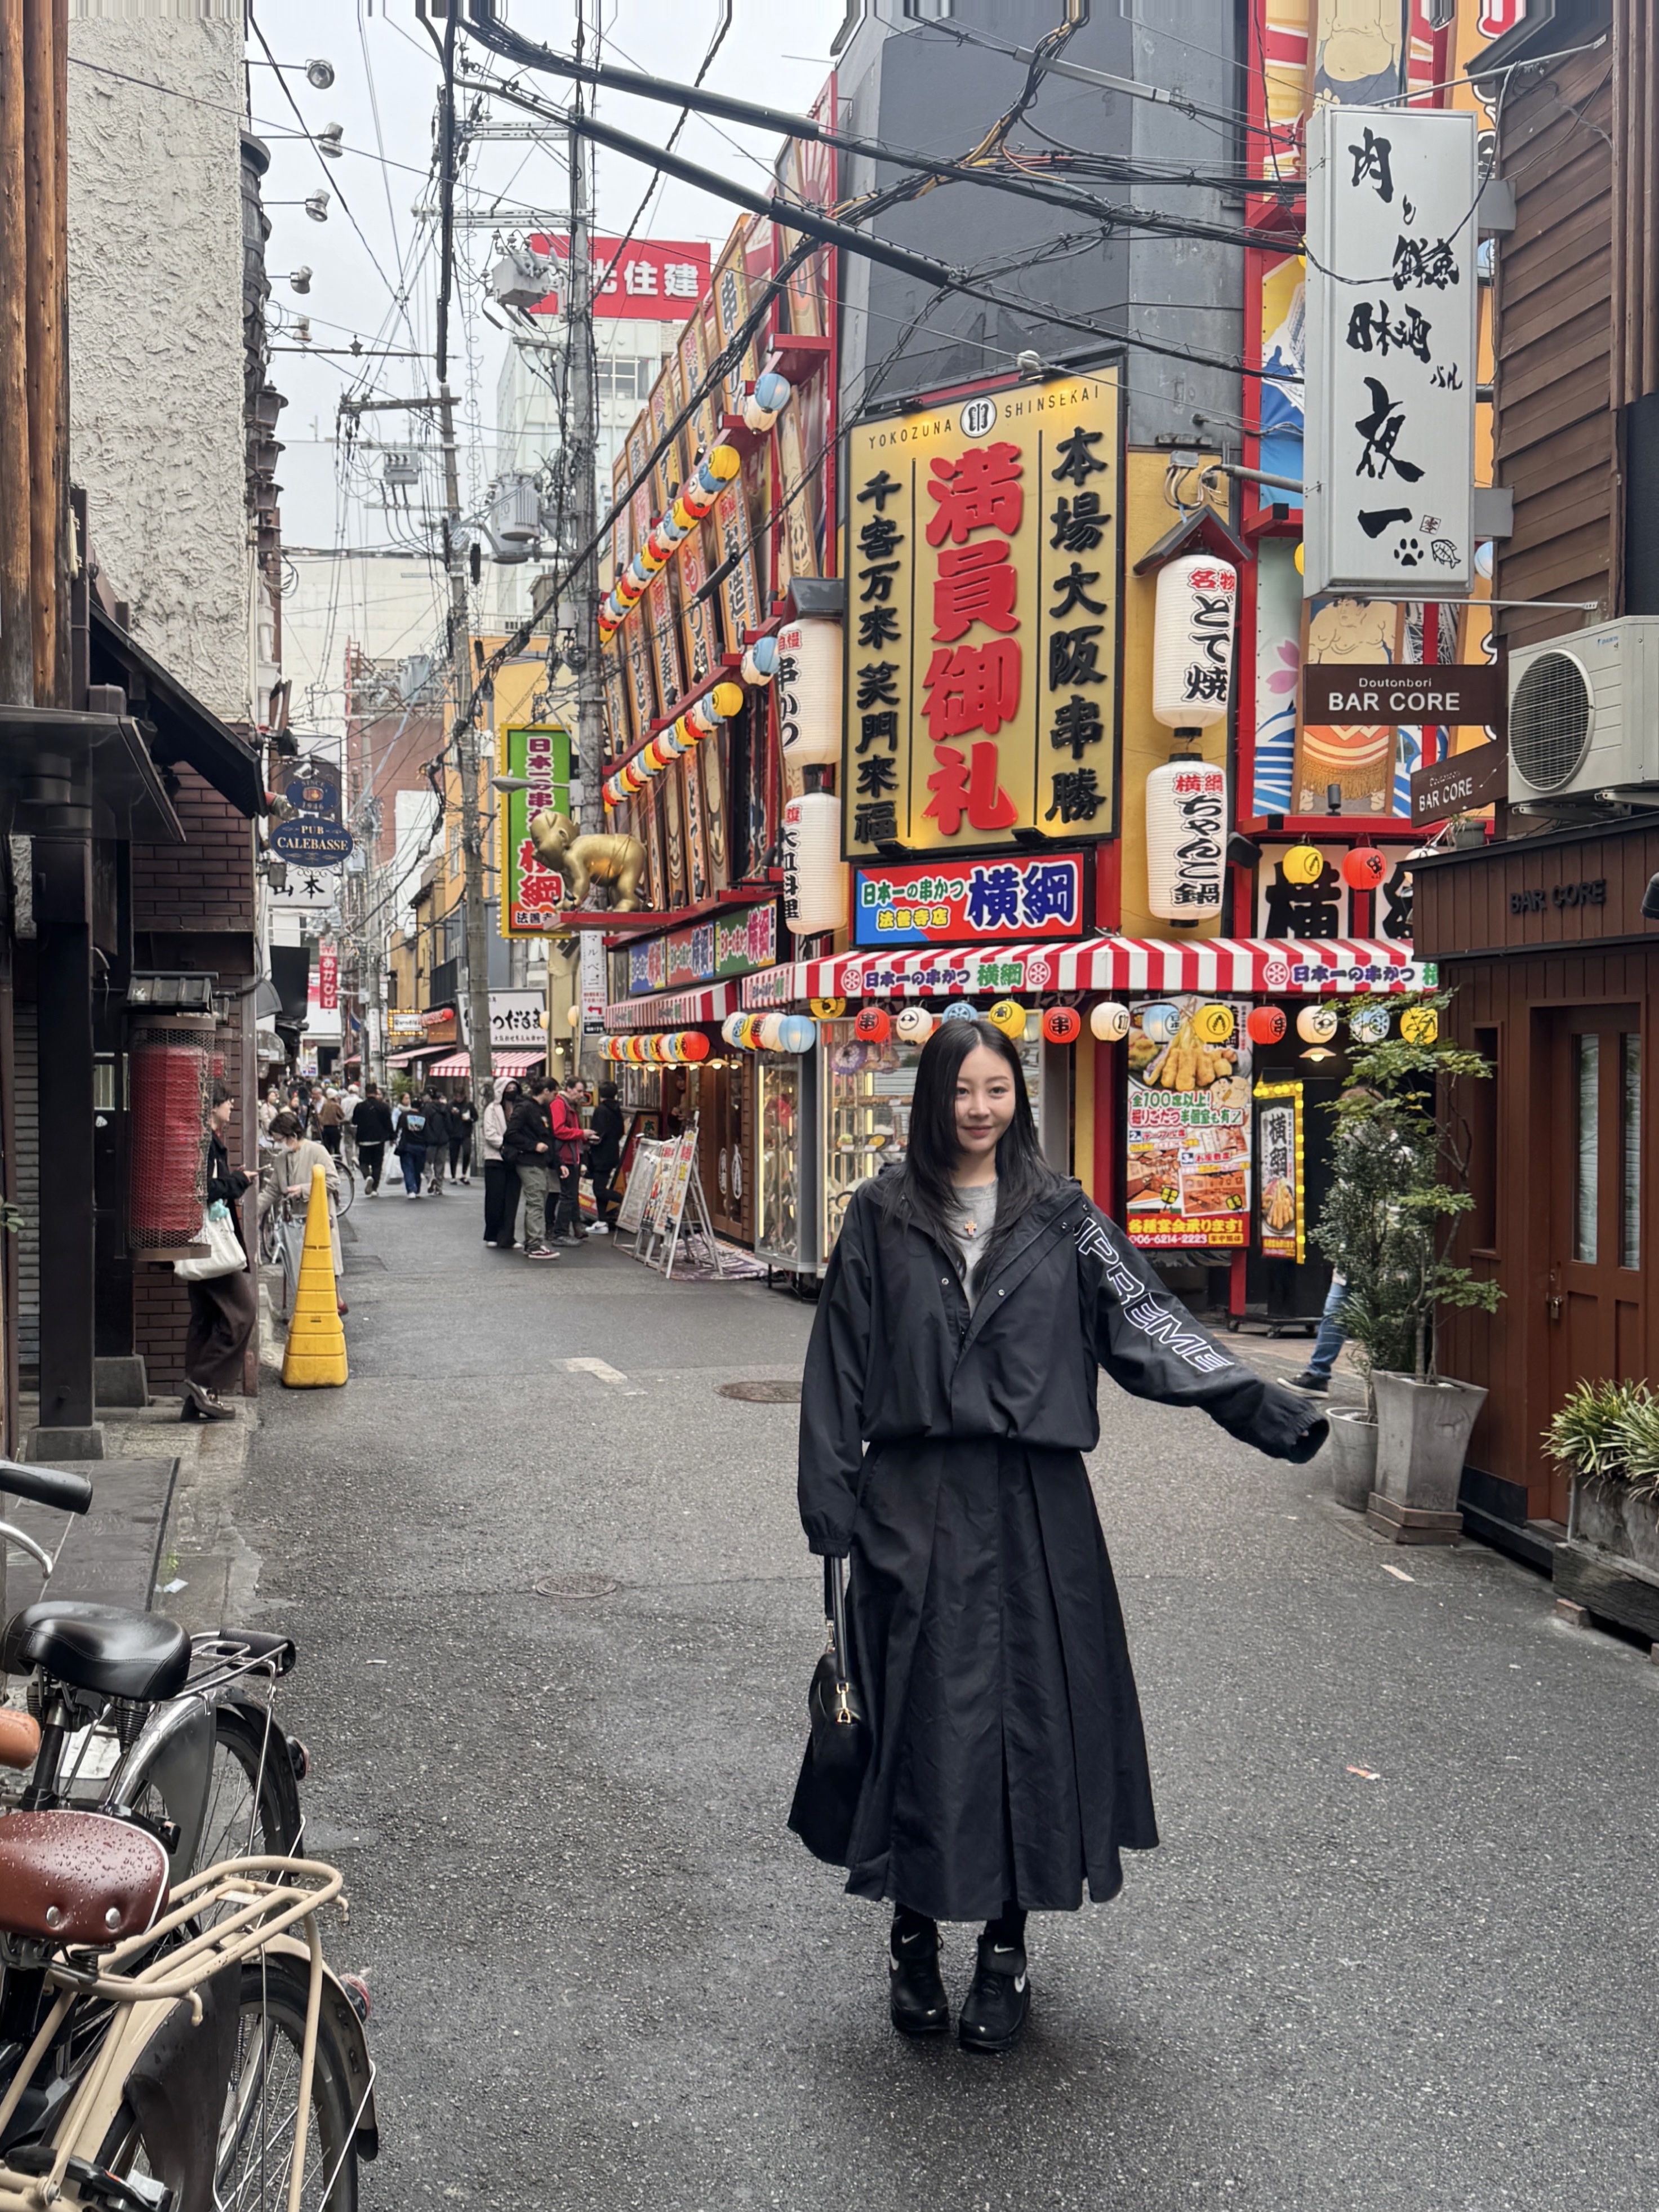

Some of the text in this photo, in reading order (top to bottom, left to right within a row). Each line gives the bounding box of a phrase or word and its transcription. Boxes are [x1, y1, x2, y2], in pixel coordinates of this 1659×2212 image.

[869, 384, 1099, 449] YOKOZUNA SHINSEKAI
[920, 442, 1024, 836] 満員御礼
[1044, 427, 1111, 824] 本場大阪串勝
[1186, 595, 1233, 701] どて焼
[1359, 678, 1431, 688] Doutonbori
[1329, 692, 1460, 711] BAR CORE
[1419, 790, 1439, 812] BAR
[1443, 777, 1473, 803] CORE
[277, 837, 348, 850] CALEBASSE
[301, 825, 324, 834] PUB
[1171, 796, 1222, 906] ちゃんこ鍋
[863, 878, 964, 906] 日本一の串かつ
[967, 865, 1074, 927] 横綱
[1510, 880, 1607, 914] BAR CORE
[866, 963, 1022, 988] 日本一の串かつ 横綱
[1293, 965, 1415, 983] 日本一の串かつ
[861, 1014, 875, 1029] 串
[1052, 1016, 1069, 1034] 串
